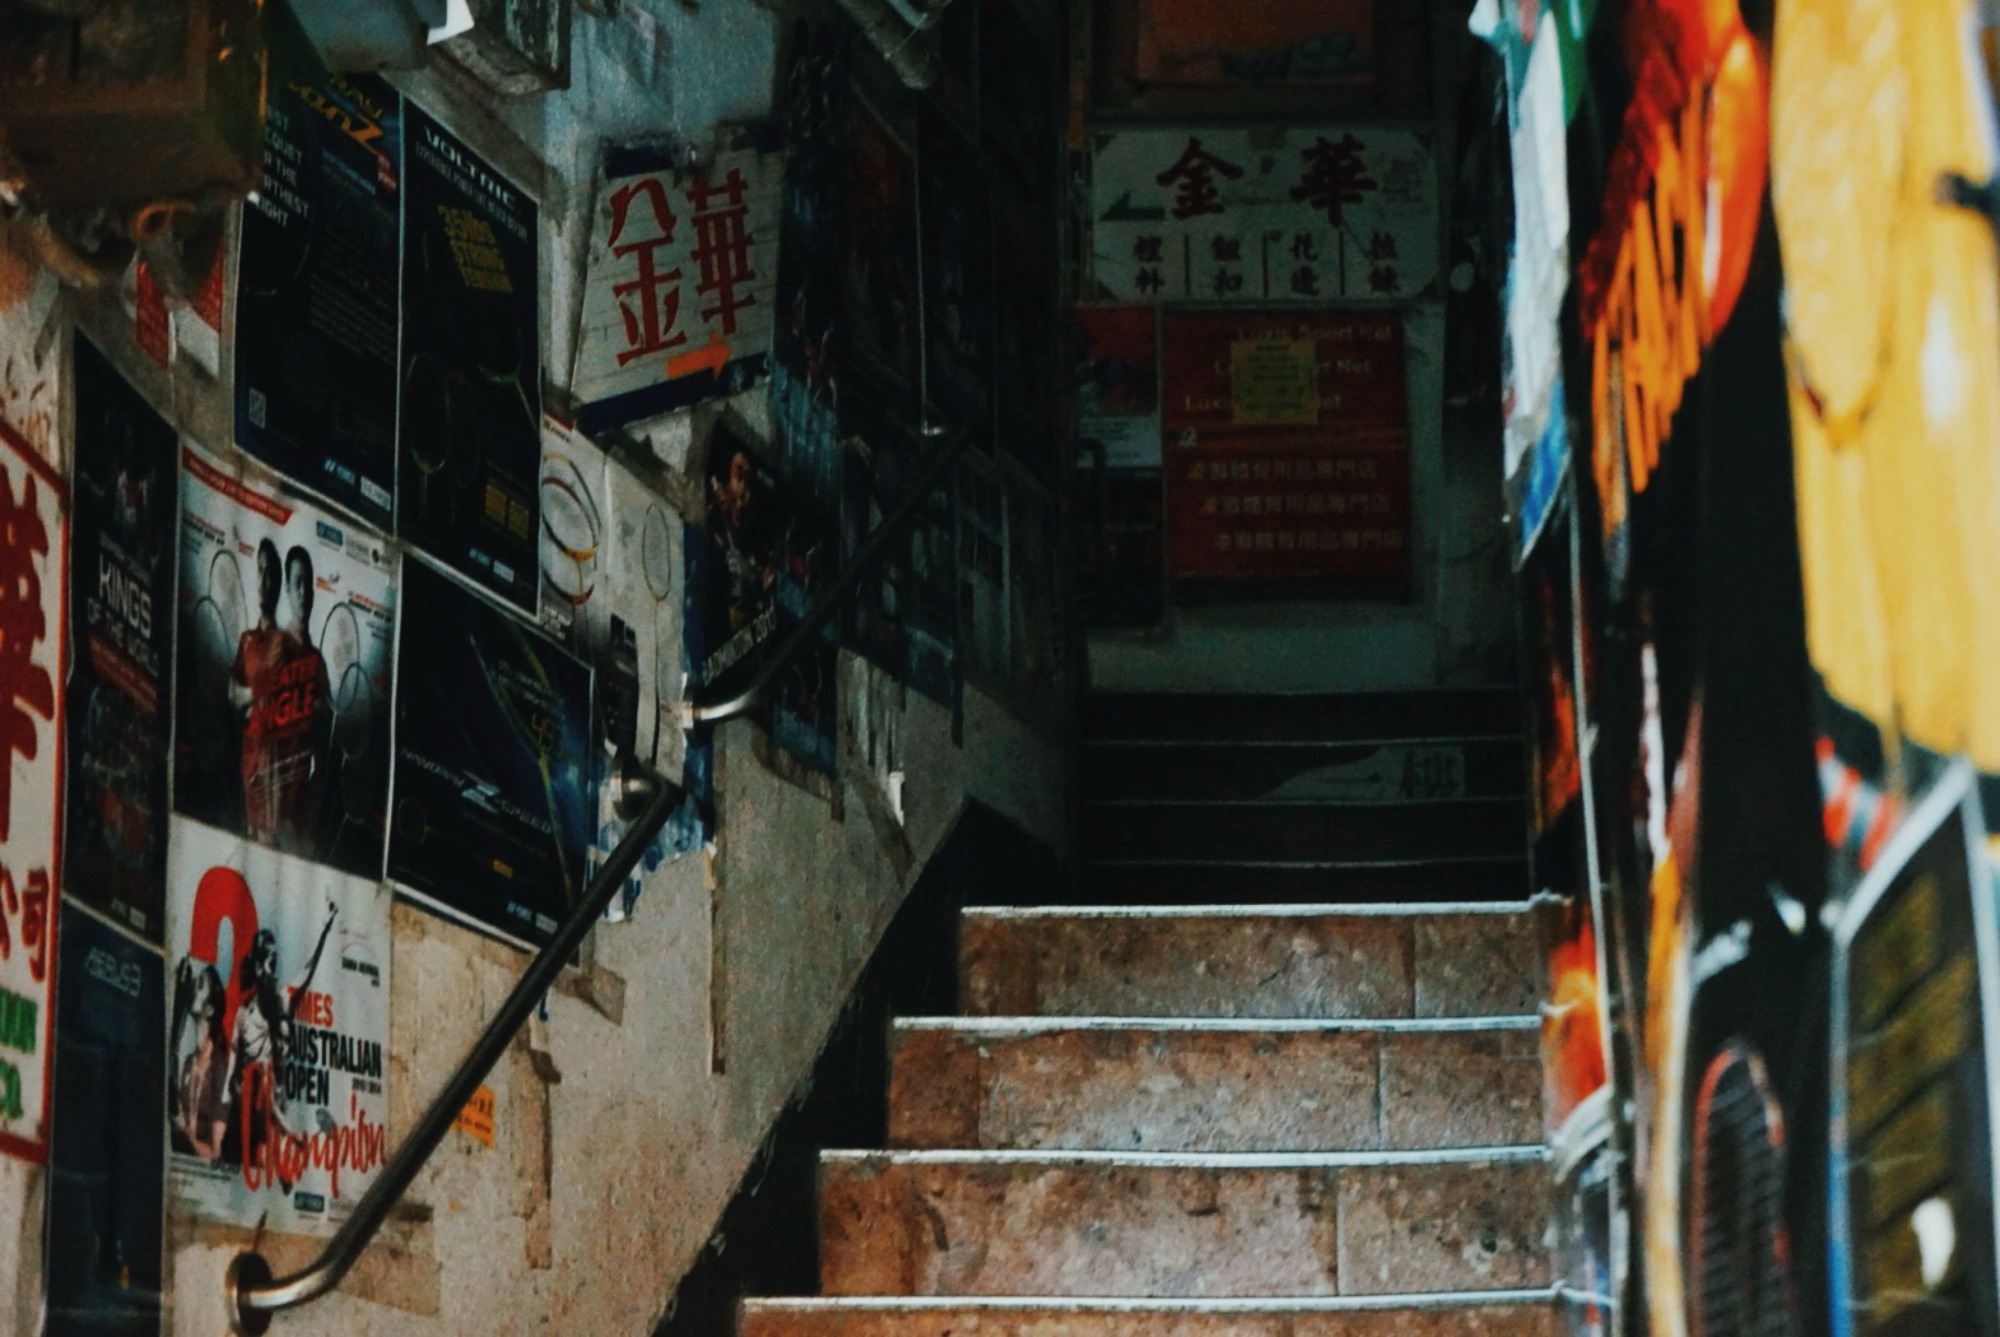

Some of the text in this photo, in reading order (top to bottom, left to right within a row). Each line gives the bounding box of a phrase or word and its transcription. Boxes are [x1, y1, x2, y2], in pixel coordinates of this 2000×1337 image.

[424, 124, 517, 211] VOLTRIC
[1156, 134, 1377, 228] 金華
[606, 168, 757, 368] 金華
[98, 553, 152, 640] KINGS
[285, 1061, 330, 1107] OPEN
[287, 1023, 382, 1078] AUSTRALIAN
[240, 1061, 388, 1198] Champion
